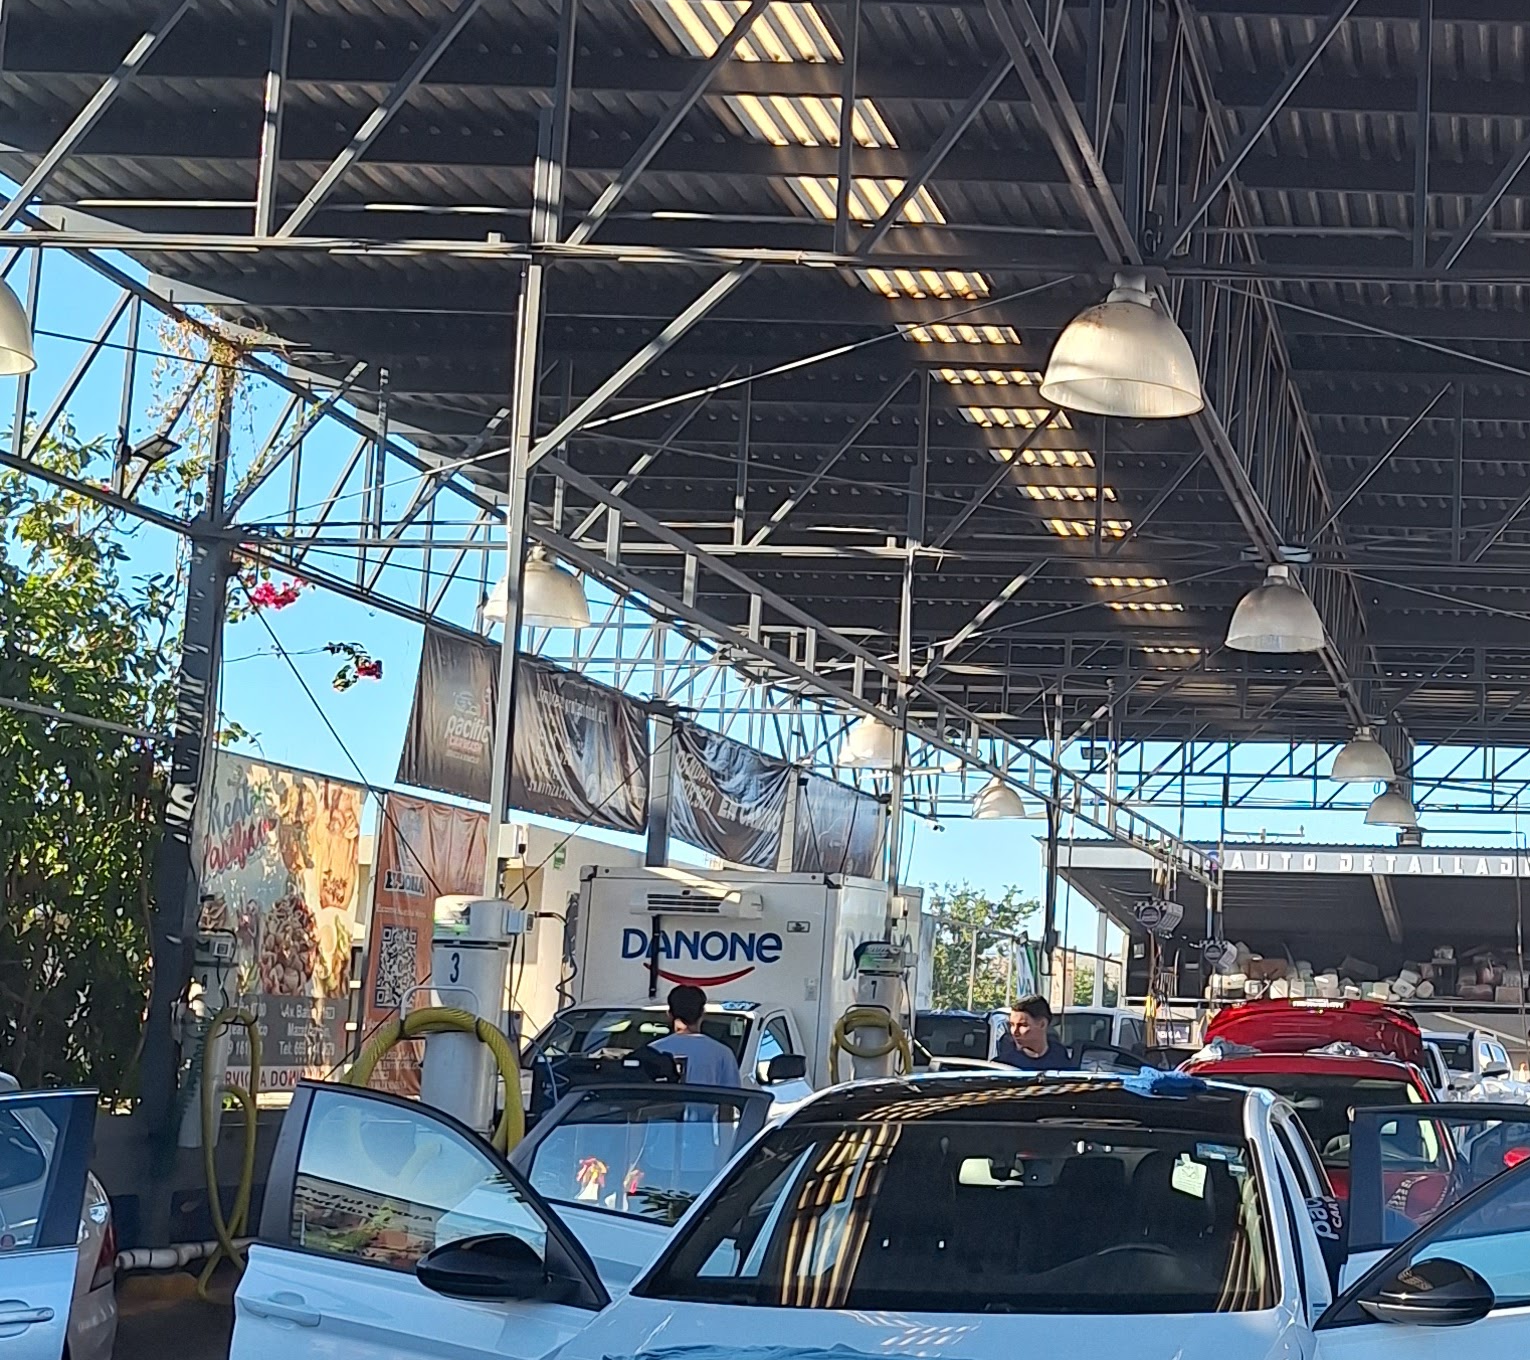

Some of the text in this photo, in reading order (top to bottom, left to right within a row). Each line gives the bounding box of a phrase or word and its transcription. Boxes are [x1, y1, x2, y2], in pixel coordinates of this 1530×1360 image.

[443, 715, 491, 743] pacific
[1231, 852, 1317, 871] AUTO
[449, 952, 460, 983] 3
[871, 980, 877, 999] 7
